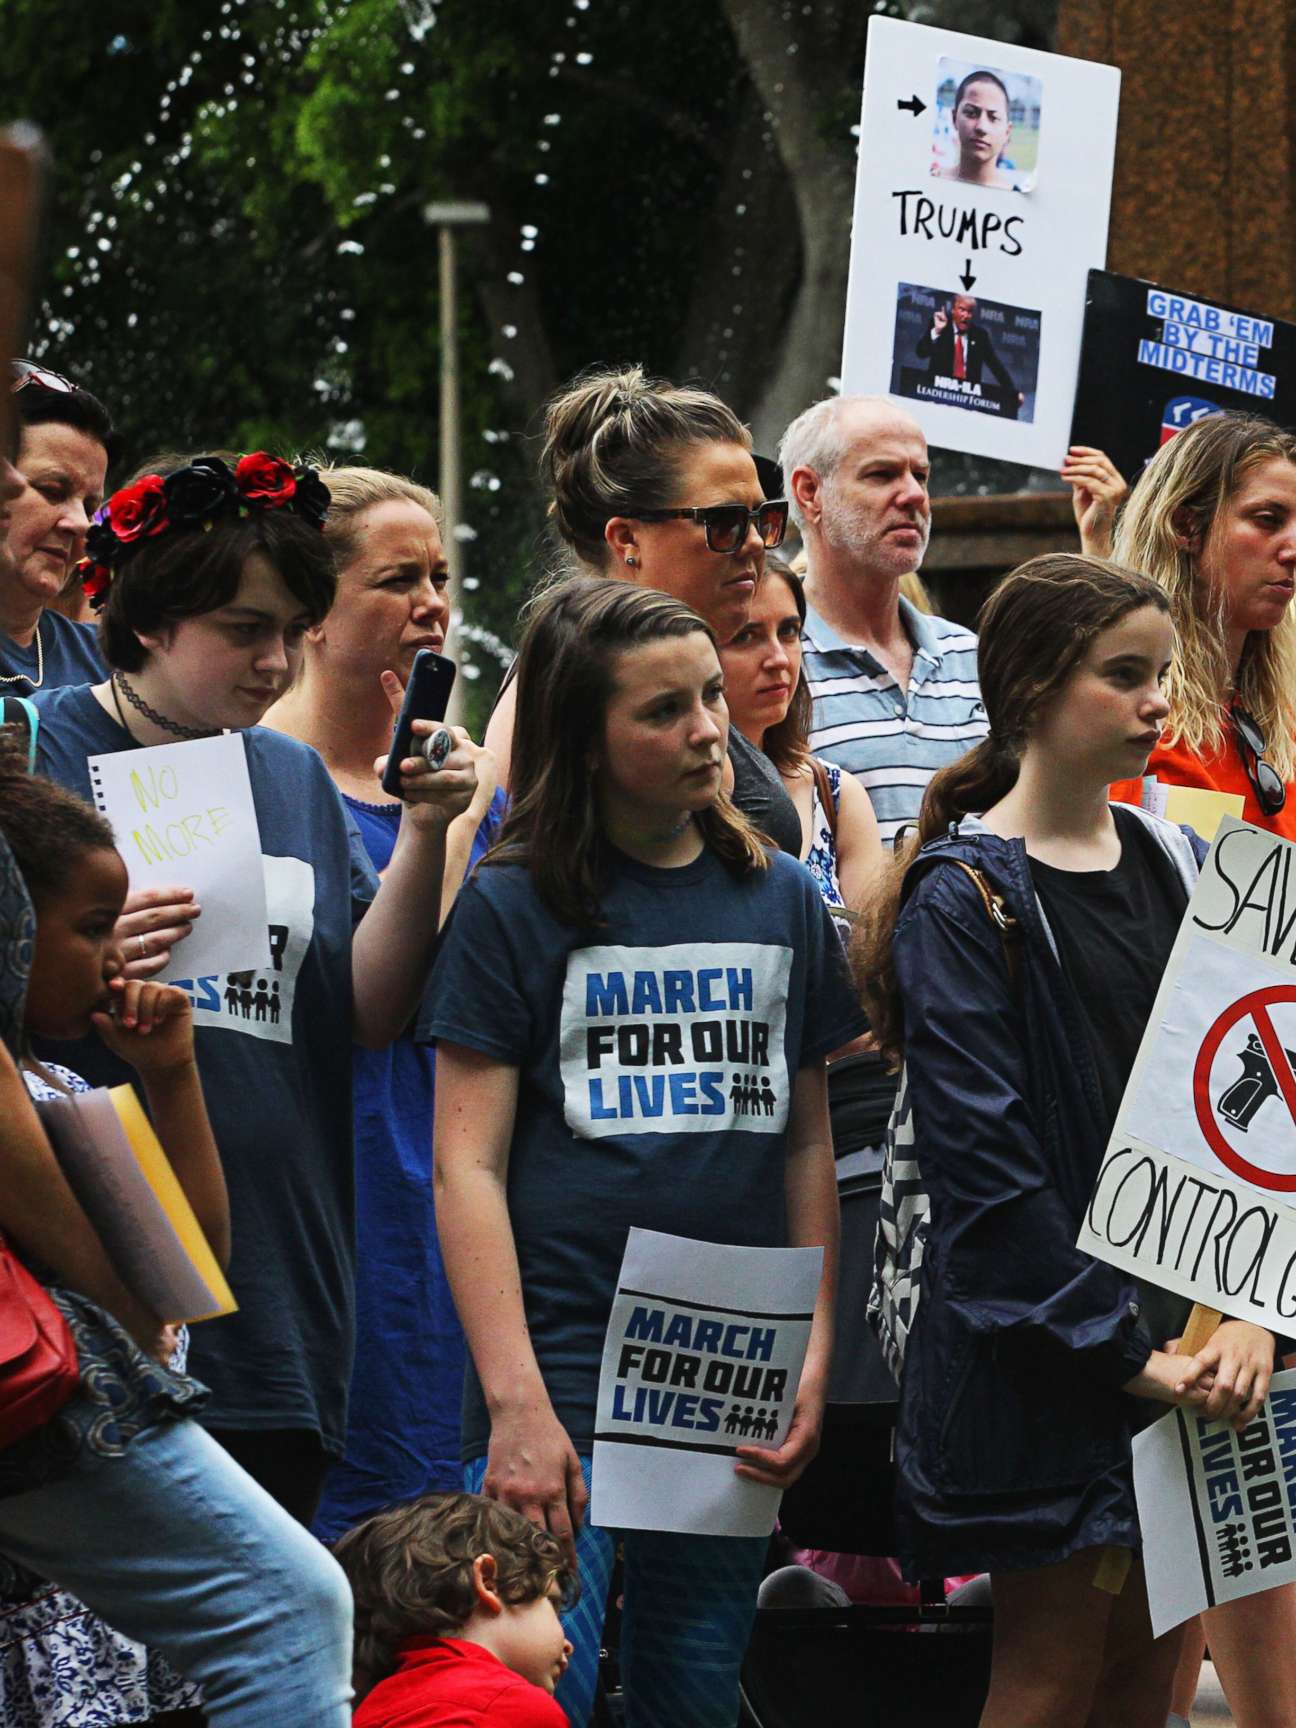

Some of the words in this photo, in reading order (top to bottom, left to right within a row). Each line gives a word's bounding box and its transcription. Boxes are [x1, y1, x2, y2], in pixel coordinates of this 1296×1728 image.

[892, 191, 1024, 256] TRUMPS
[1150, 294, 1220, 331] GRAB
[1140, 341, 1273, 397] MIDTERMS
[1165, 322, 1199, 350] BY
[1209, 335, 1258, 368] THE
[934, 375, 981, 396] NRA-ILA
[130, 765, 178, 812] NO
[132, 807, 230, 865] MORE
[585, 968, 753, 1017] MARCH
[587, 1023, 685, 1070] FOR
[691, 1020, 769, 1066] OUR
[588, 1072, 725, 1120] LIVES
[1089, 1148, 1279, 1308] CONTROL
[624, 1306, 776, 1362] MARCH
[617, 1344, 702, 1388] FOR
[703, 1360, 788, 1402] OUR
[611, 1384, 725, 1432] LIVES
[1247, 1480, 1292, 1569] OUR
